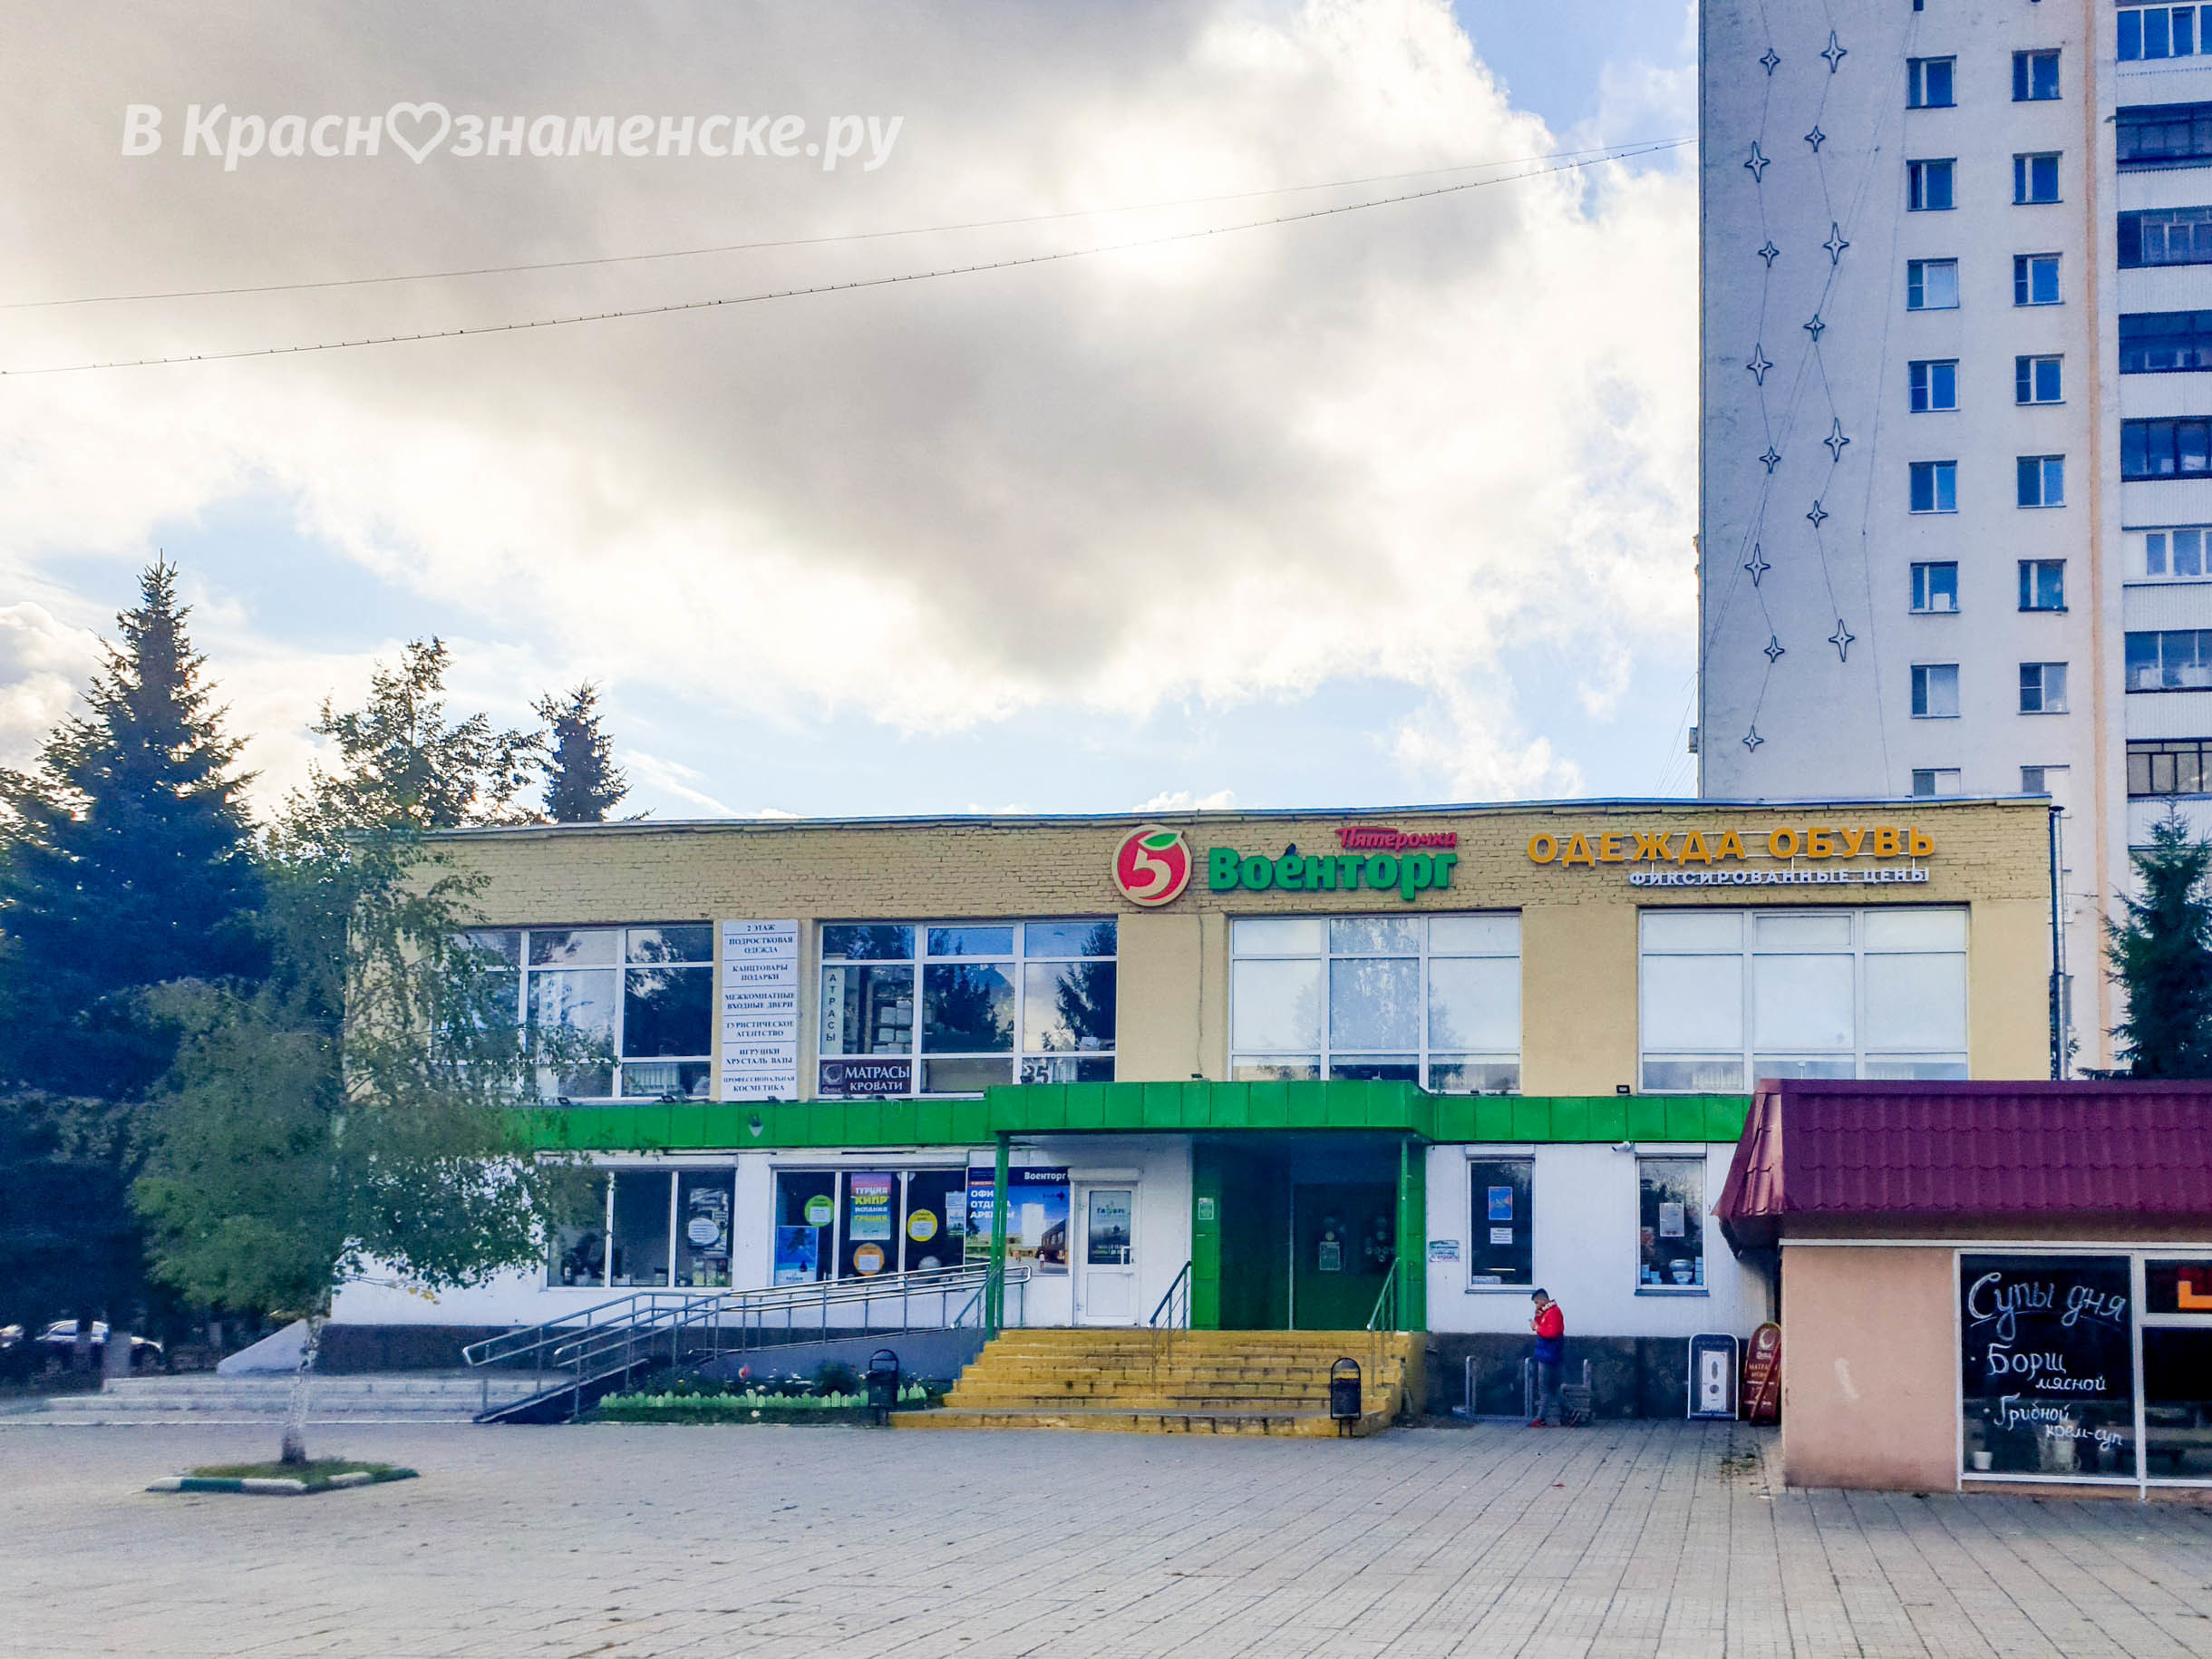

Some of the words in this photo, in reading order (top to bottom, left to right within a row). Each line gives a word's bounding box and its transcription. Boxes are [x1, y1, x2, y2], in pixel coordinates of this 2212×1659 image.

[1334, 826, 1458, 852] Пятерочка
[1528, 829, 1747, 868] ОДЕЖДА
[1768, 825, 1936, 859] ОБУВЬ
[1208, 847, 1458, 901] Военторг
[1629, 868, 1850, 886] ФИКСИРОВАННЫЕ
[1863, 867, 1930, 884] ЦЕНЫ
[728, 936, 793, 946] ПОДРОСТКОВАЯ
[732, 964, 789, 973] КАНЦТОВАРЫ
[741, 973, 780, 981] ПОДАРКИ
[724, 993, 794, 1001] МЕЖКОМНАТНЫЕ
[767, 1001, 794, 1009] ДВЕРИ
[826, 966, 837, 1042] АТРАСЫ
[726, 1021, 793, 1029] ТУРИСТИЧЕСКОЕ
[739, 1048, 780, 1056] ИГРУШКИ
[726, 1057, 768, 1065] ХРУСТАЛЬ
[844, 1065, 910, 1079] МАТРАСЫ
[732, 1084, 785, 1092] КОСМЕТИКА
[849, 1081, 903, 1091] КРОВАТИ
[1024, 1171, 1067, 1182] Военторг
[970, 1189, 994, 1198] ОФИ
[854, 1195, 889, 1206] КИПР
[1968, 1271, 2055, 1342] Супы
[2061, 1285, 2127, 1327] дня
[1986, 1343, 2067, 1382] Борщ
[2034, 1374, 2108, 1392] мясной
[1993, 1392, 2071, 1431] Грибной
[2045, 1423, 2124, 1451] крем-суп
